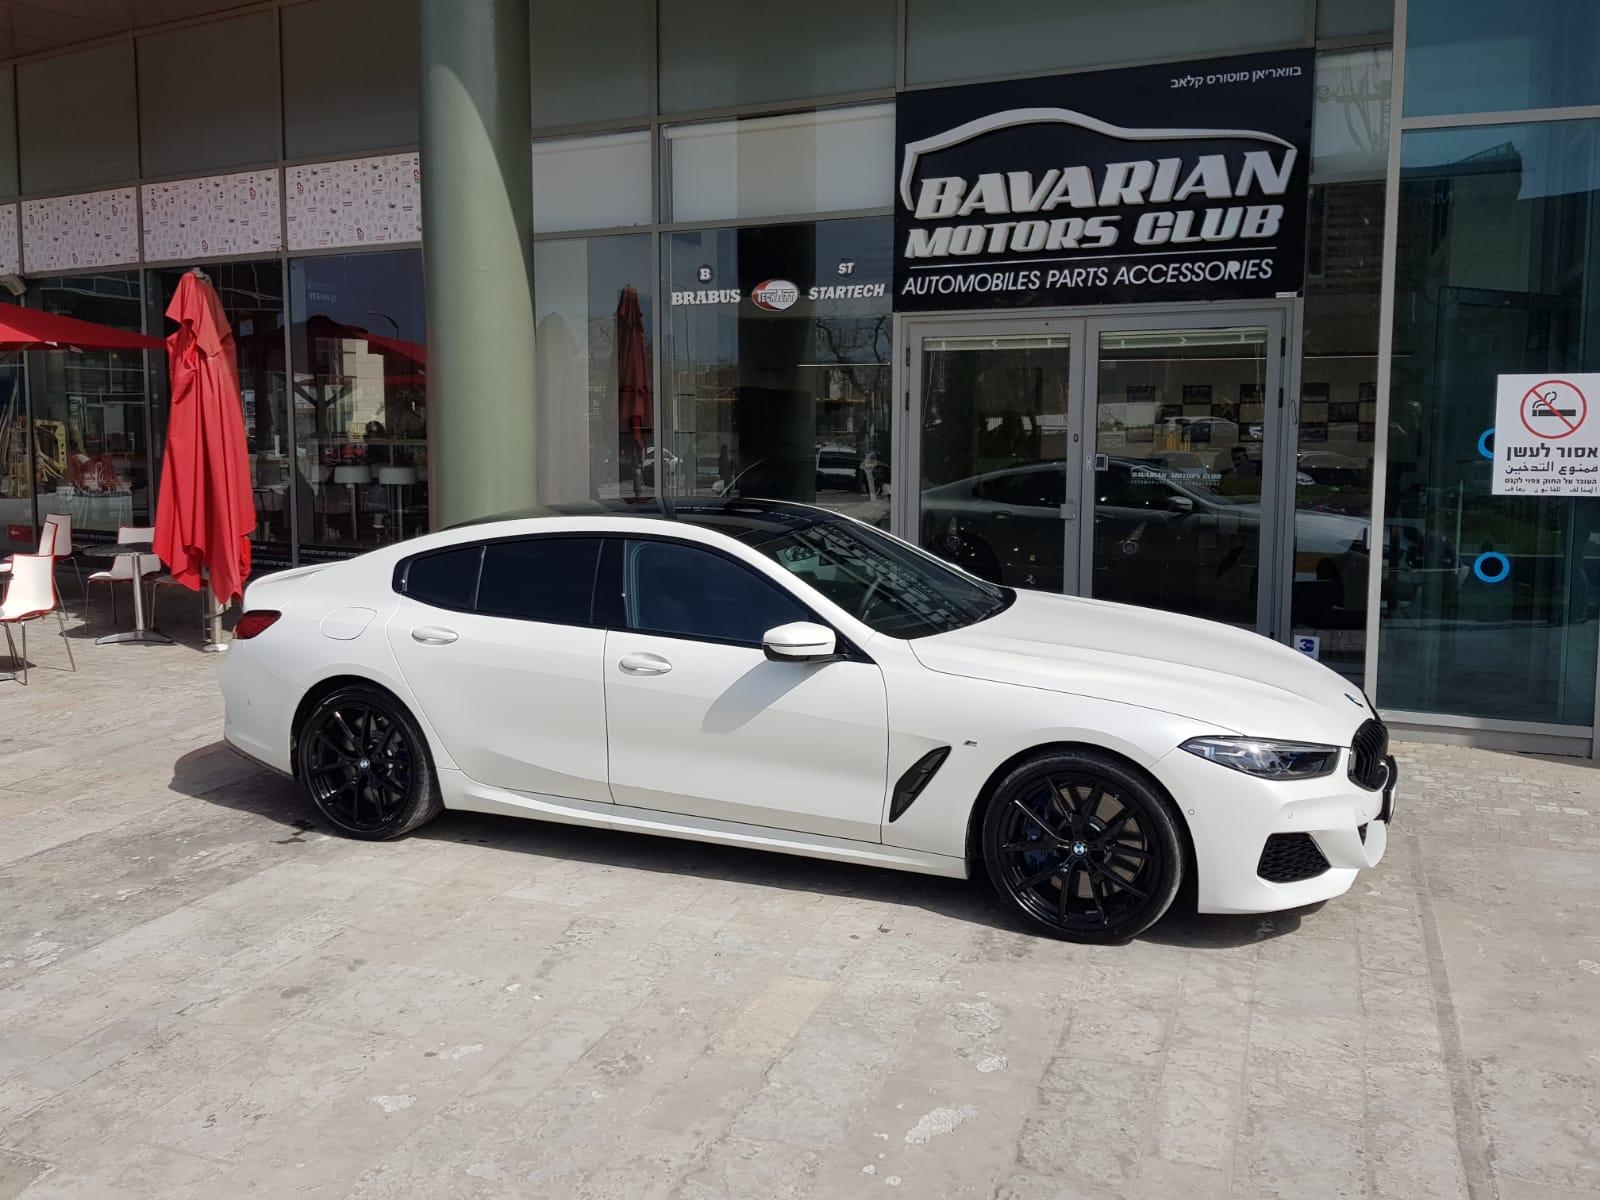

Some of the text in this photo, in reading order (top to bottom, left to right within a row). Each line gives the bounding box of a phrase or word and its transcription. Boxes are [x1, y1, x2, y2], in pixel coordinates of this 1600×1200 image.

[1170, 66, 1302, 88] בוואריאן מוטורס קלאב
[914, 149, 1298, 220] BAVARIAN
[904, 204, 1284, 259] MOTORS CLUB
[699, 268, 711, 281] B
[837, 262, 855, 275] ST
[902, 258, 1274, 296] AUTOMOBILES PARTS ACCESSORIES
[671, 289, 742, 306] BRABUS
[808, 283, 886, 301] STARTECH
[1506, 443, 1599, 461] אסור לעשן
[1505, 461, 1598, 476] ممنوع التدخين
